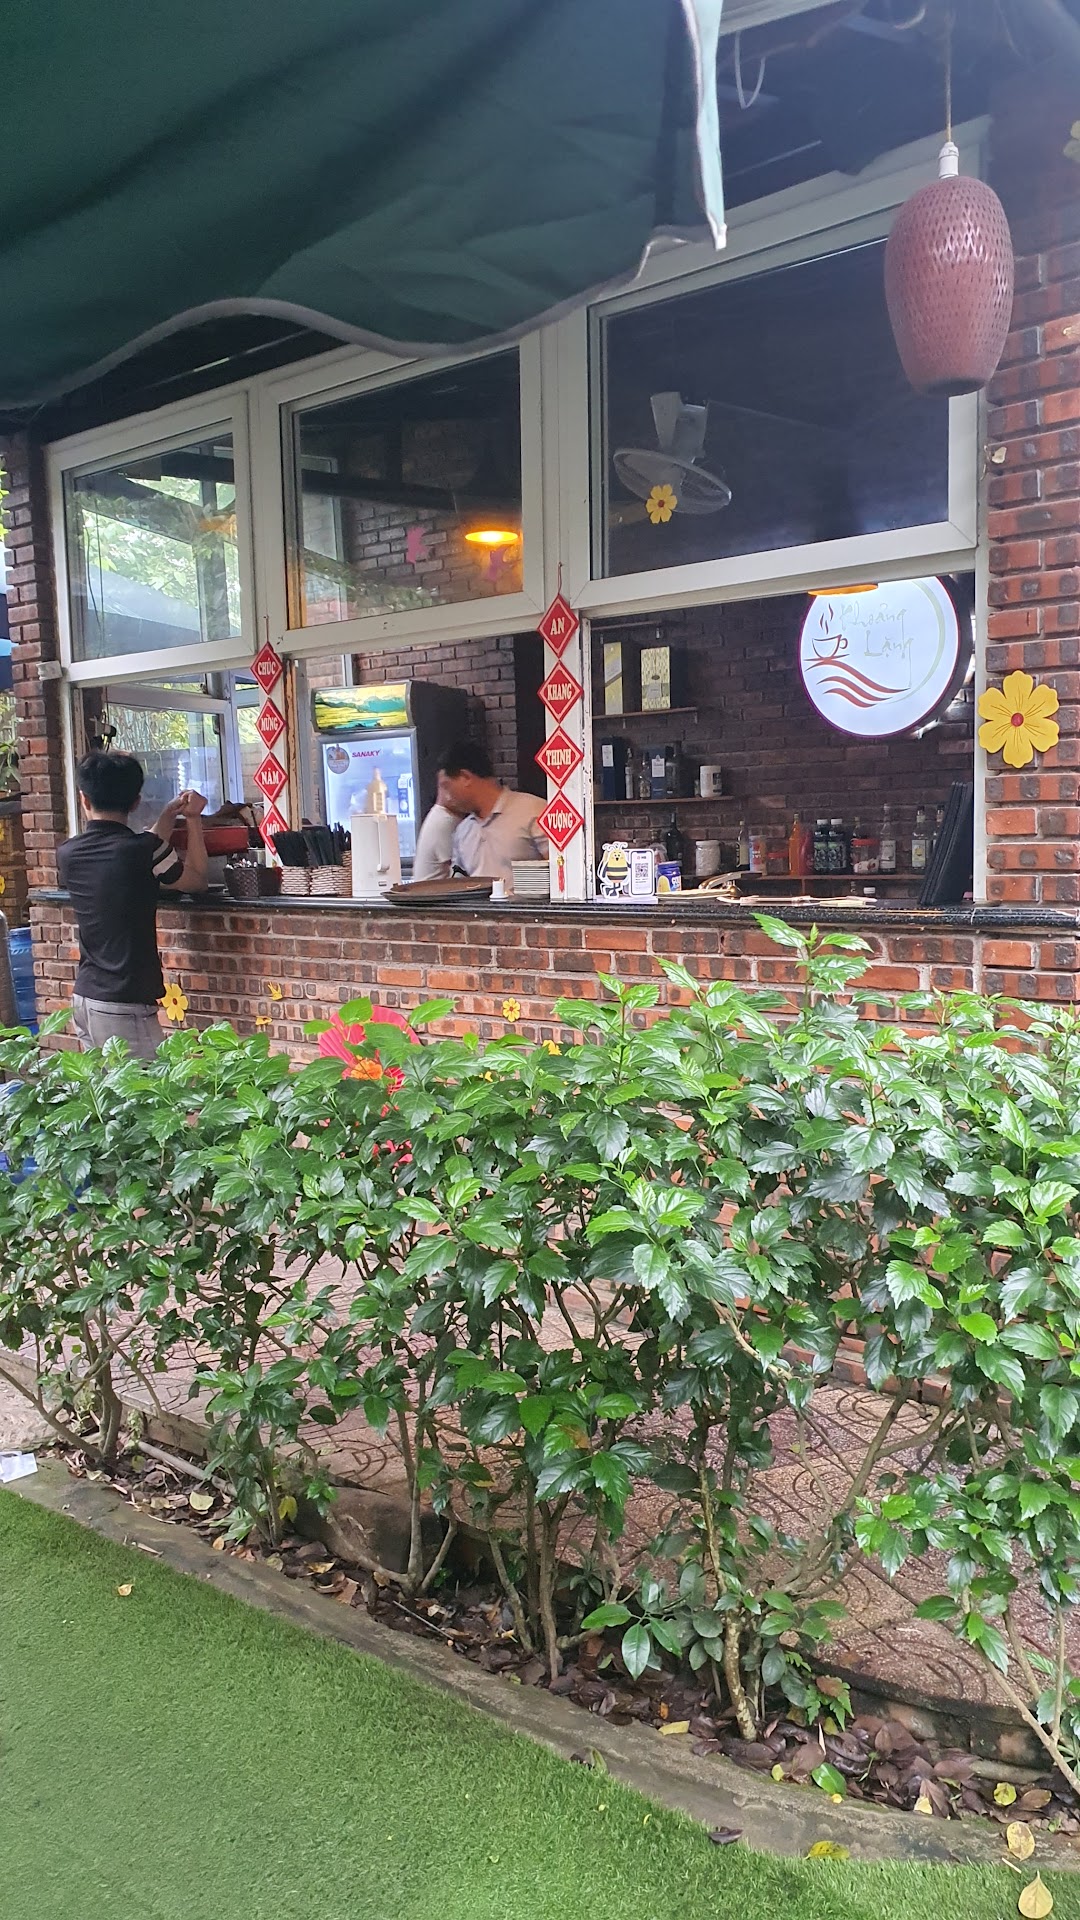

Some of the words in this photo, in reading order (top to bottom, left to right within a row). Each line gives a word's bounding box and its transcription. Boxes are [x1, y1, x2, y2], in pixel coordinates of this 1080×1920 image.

[550, 617, 565, 635] AN
[257, 658, 276, 675] CHÚC
[864, 630, 914, 688] Lặng
[547, 683, 572, 700] KHANG
[261, 714, 278, 731] MỪNG
[352, 749, 381, 758] SANAKY
[546, 748, 571, 769] THỊNH
[547, 811, 573, 832] VƯỢNG
